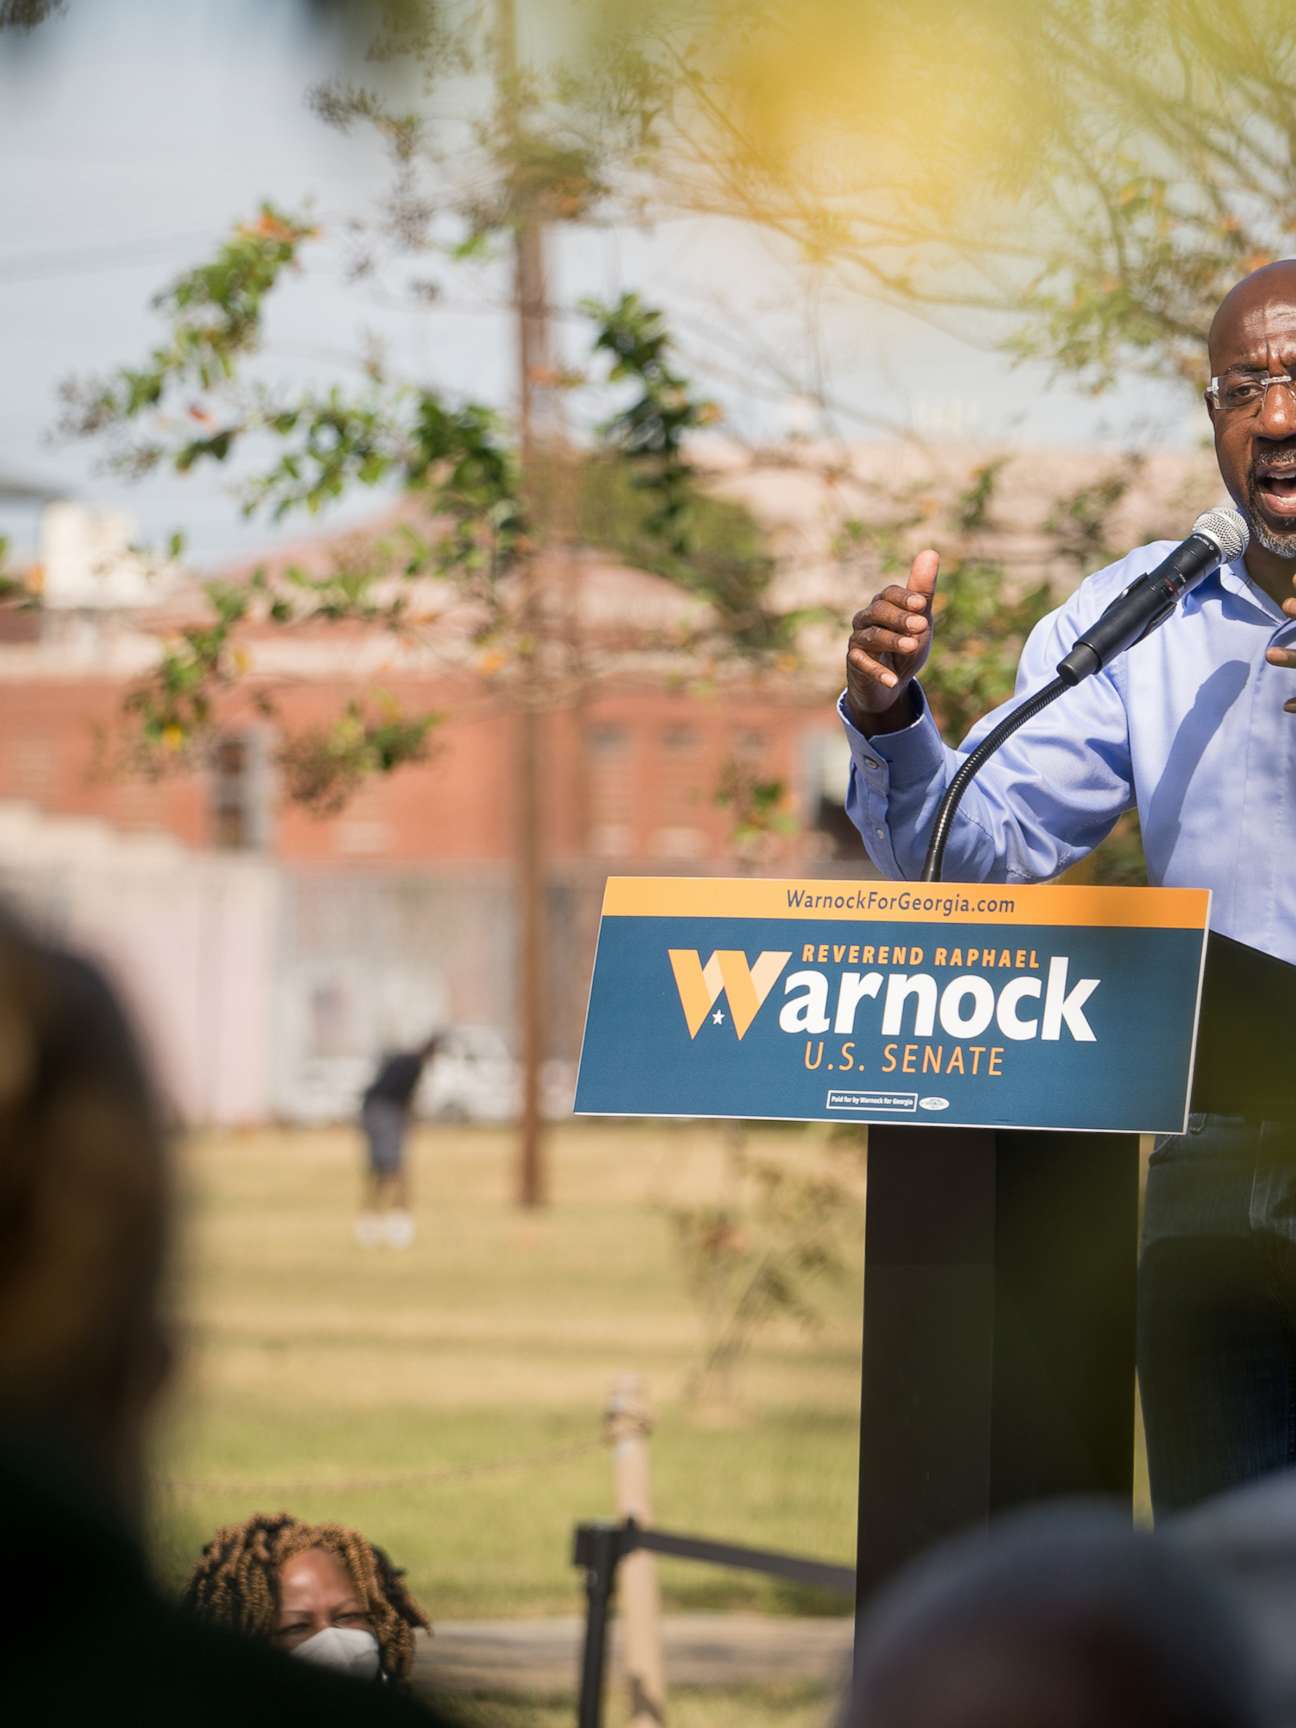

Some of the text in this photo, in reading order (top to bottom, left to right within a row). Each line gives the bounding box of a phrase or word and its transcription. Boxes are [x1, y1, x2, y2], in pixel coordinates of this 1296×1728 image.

[786, 889, 1015, 916] WarnockForGeorgia.com
[801, 943, 1041, 969] REVEREND RAPHAEL
[668, 948, 1101, 1042] Warnock
[804, 1041, 1005, 1075] U.S. SENATE
[831, 1095, 844, 1104] Paid
[844, 1096, 852, 1104] for
[852, 1096, 860, 1105] by
[860, 1096, 883, 1105] Warnock
[884, 1097, 892, 1105] for
[893, 1098, 914, 1106] Georgia
